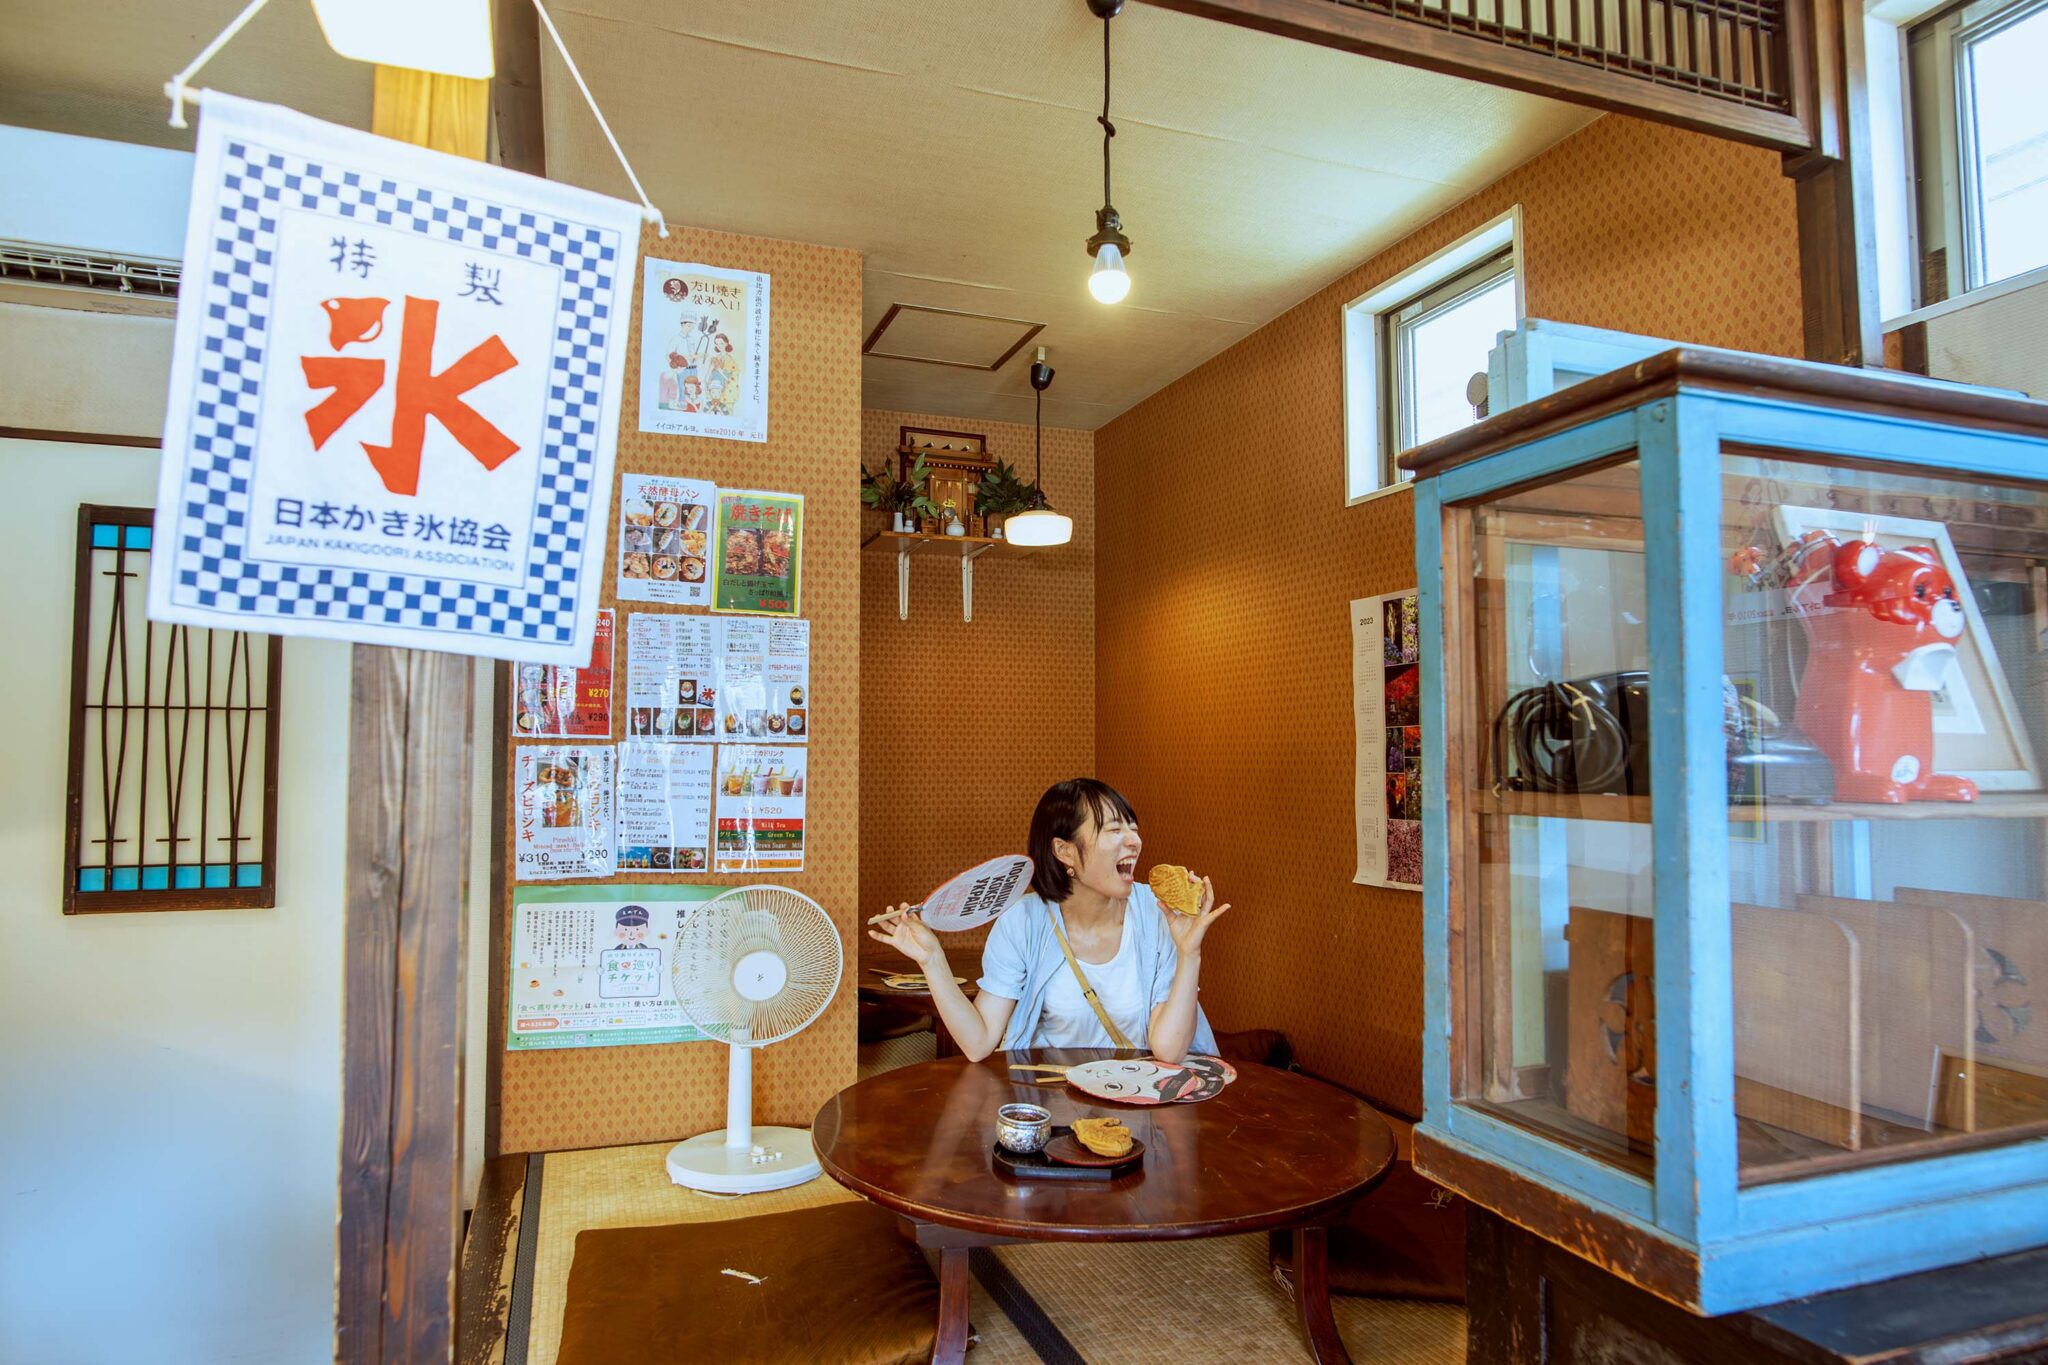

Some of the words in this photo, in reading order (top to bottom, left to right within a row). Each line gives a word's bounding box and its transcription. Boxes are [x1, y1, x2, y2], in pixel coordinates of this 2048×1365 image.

[690, 280, 742, 299] たい焼き
[691, 293, 741, 311] なみへい
[300, 295, 521, 496] 氷
[637, 485, 701, 500] 天然酵母パン
[730, 504, 793, 524] 焼きそば
[274, 497, 512, 552] 日本かき氷協会
[265, 533, 320, 549] JAPAN
[323, 538, 410, 559] KAKIGOORI
[413, 549, 516, 572] ASSOCIATION
[1359, 617, 1374, 626] 2023
[588, 688, 609, 698] ¥270
[588, 712, 609, 722] ¥290
[521, 755, 536, 843] チーズピロシキ
[759, 807, 783, 815] ¥520
[519, 853, 550, 863] ¥310
[960, 876, 991, 917] УКРАЇНІ
[978, 875, 1007, 911] КОКЕСІ
[987, 860, 1028, 917] ПОСМІШКА
[607, 972, 655, 984] チケット
